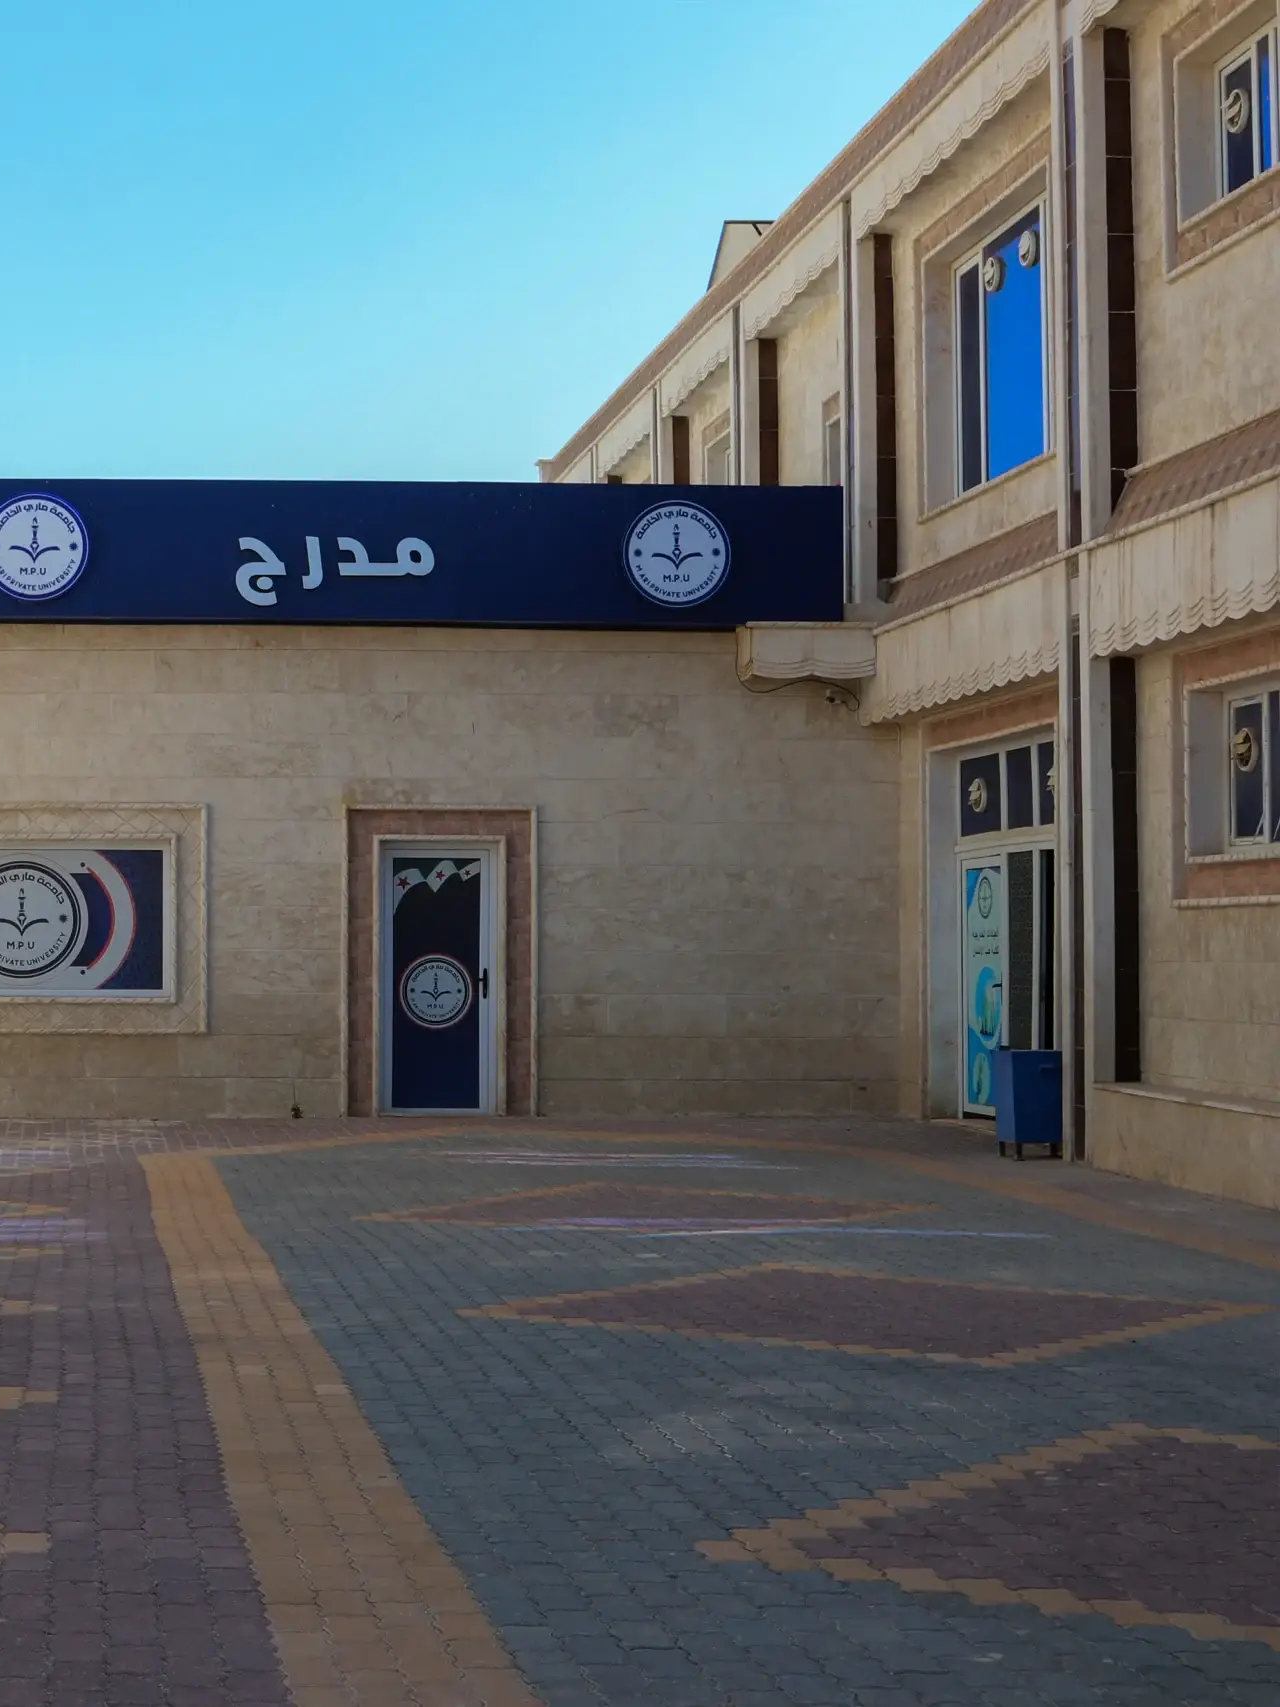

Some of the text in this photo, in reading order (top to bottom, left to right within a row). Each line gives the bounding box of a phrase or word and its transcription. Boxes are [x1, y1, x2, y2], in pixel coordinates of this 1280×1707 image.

[23, 502, 48, 512] ماري
[49, 505, 76, 534] جامعة
[636, 508, 717, 539] جامعة ماري الخاصة
[6, 575, 36, 591] PRIVATE
[38, 558, 76, 591] UNIVERSITY
[19, 567, 47, 575] M.P.U
[234, 535, 436, 606] مدرج
[650, 583, 680, 598] PRIVATE
[682, 564, 719, 598] UNIVERSITY
[663, 574, 690, 582] M.P.U
[9, 871, 35, 882] ماري
[36, 875, 65, 905] جامعة
[6, 941, 35, 950] M.P.U
[26, 931, 67, 966] UNIVERSITY
